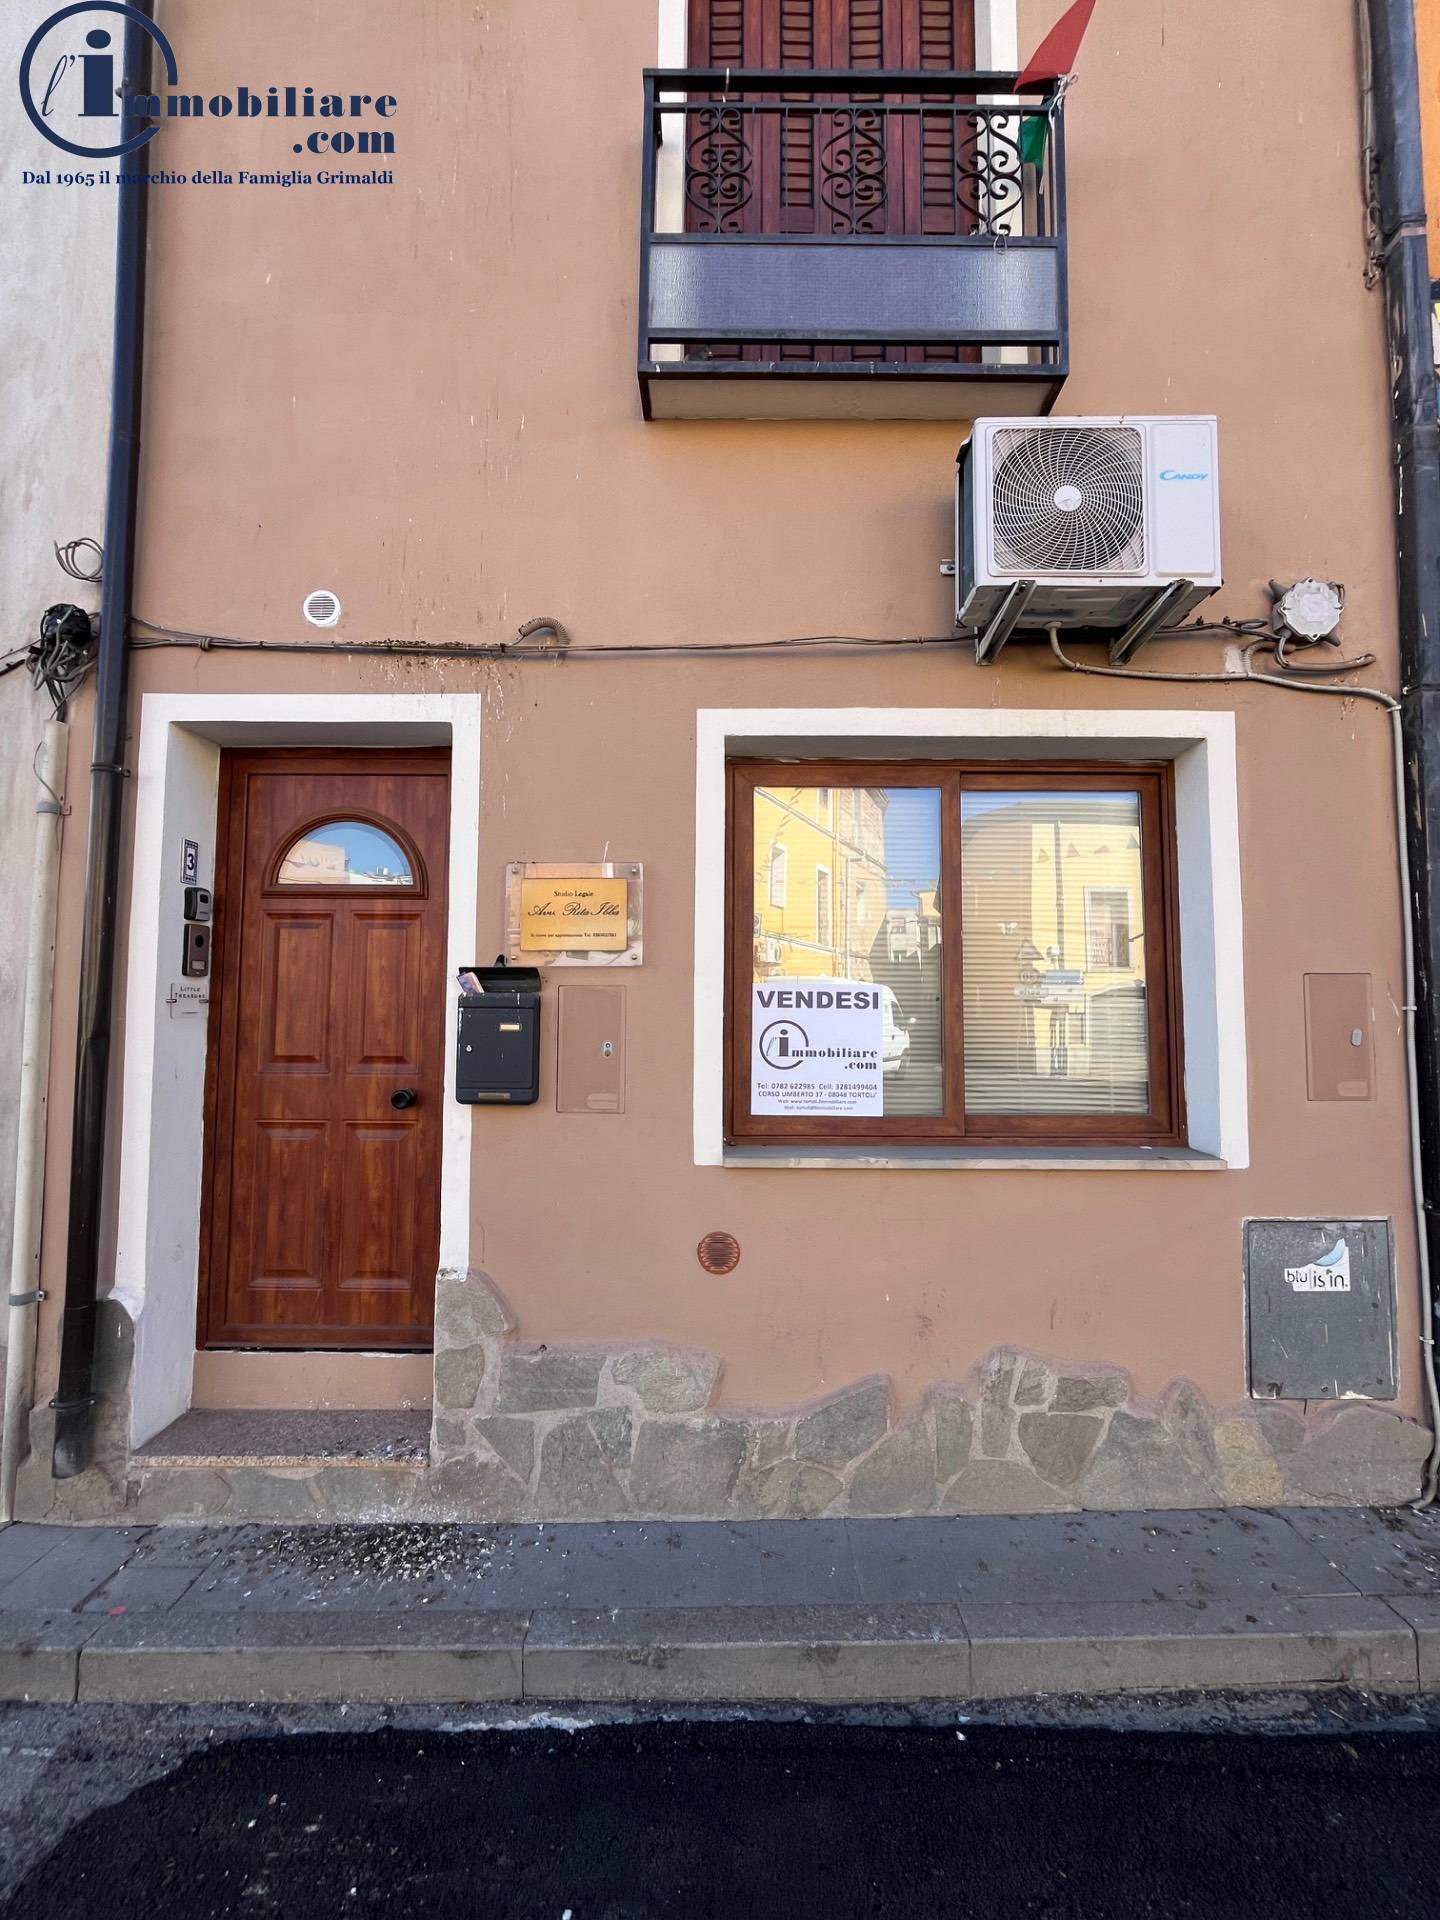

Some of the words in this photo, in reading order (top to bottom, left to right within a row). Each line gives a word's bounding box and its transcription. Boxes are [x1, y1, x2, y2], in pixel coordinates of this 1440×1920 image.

[187, 853, 194, 870] 3
[574, 890, 594, 898] Legale
[756, 990, 879, 1010] VENDESI
[844, 1061, 877, 1070] .com
[1287, 1270, 1308, 1283] blu
[1313, 1270, 1326, 1288] is
